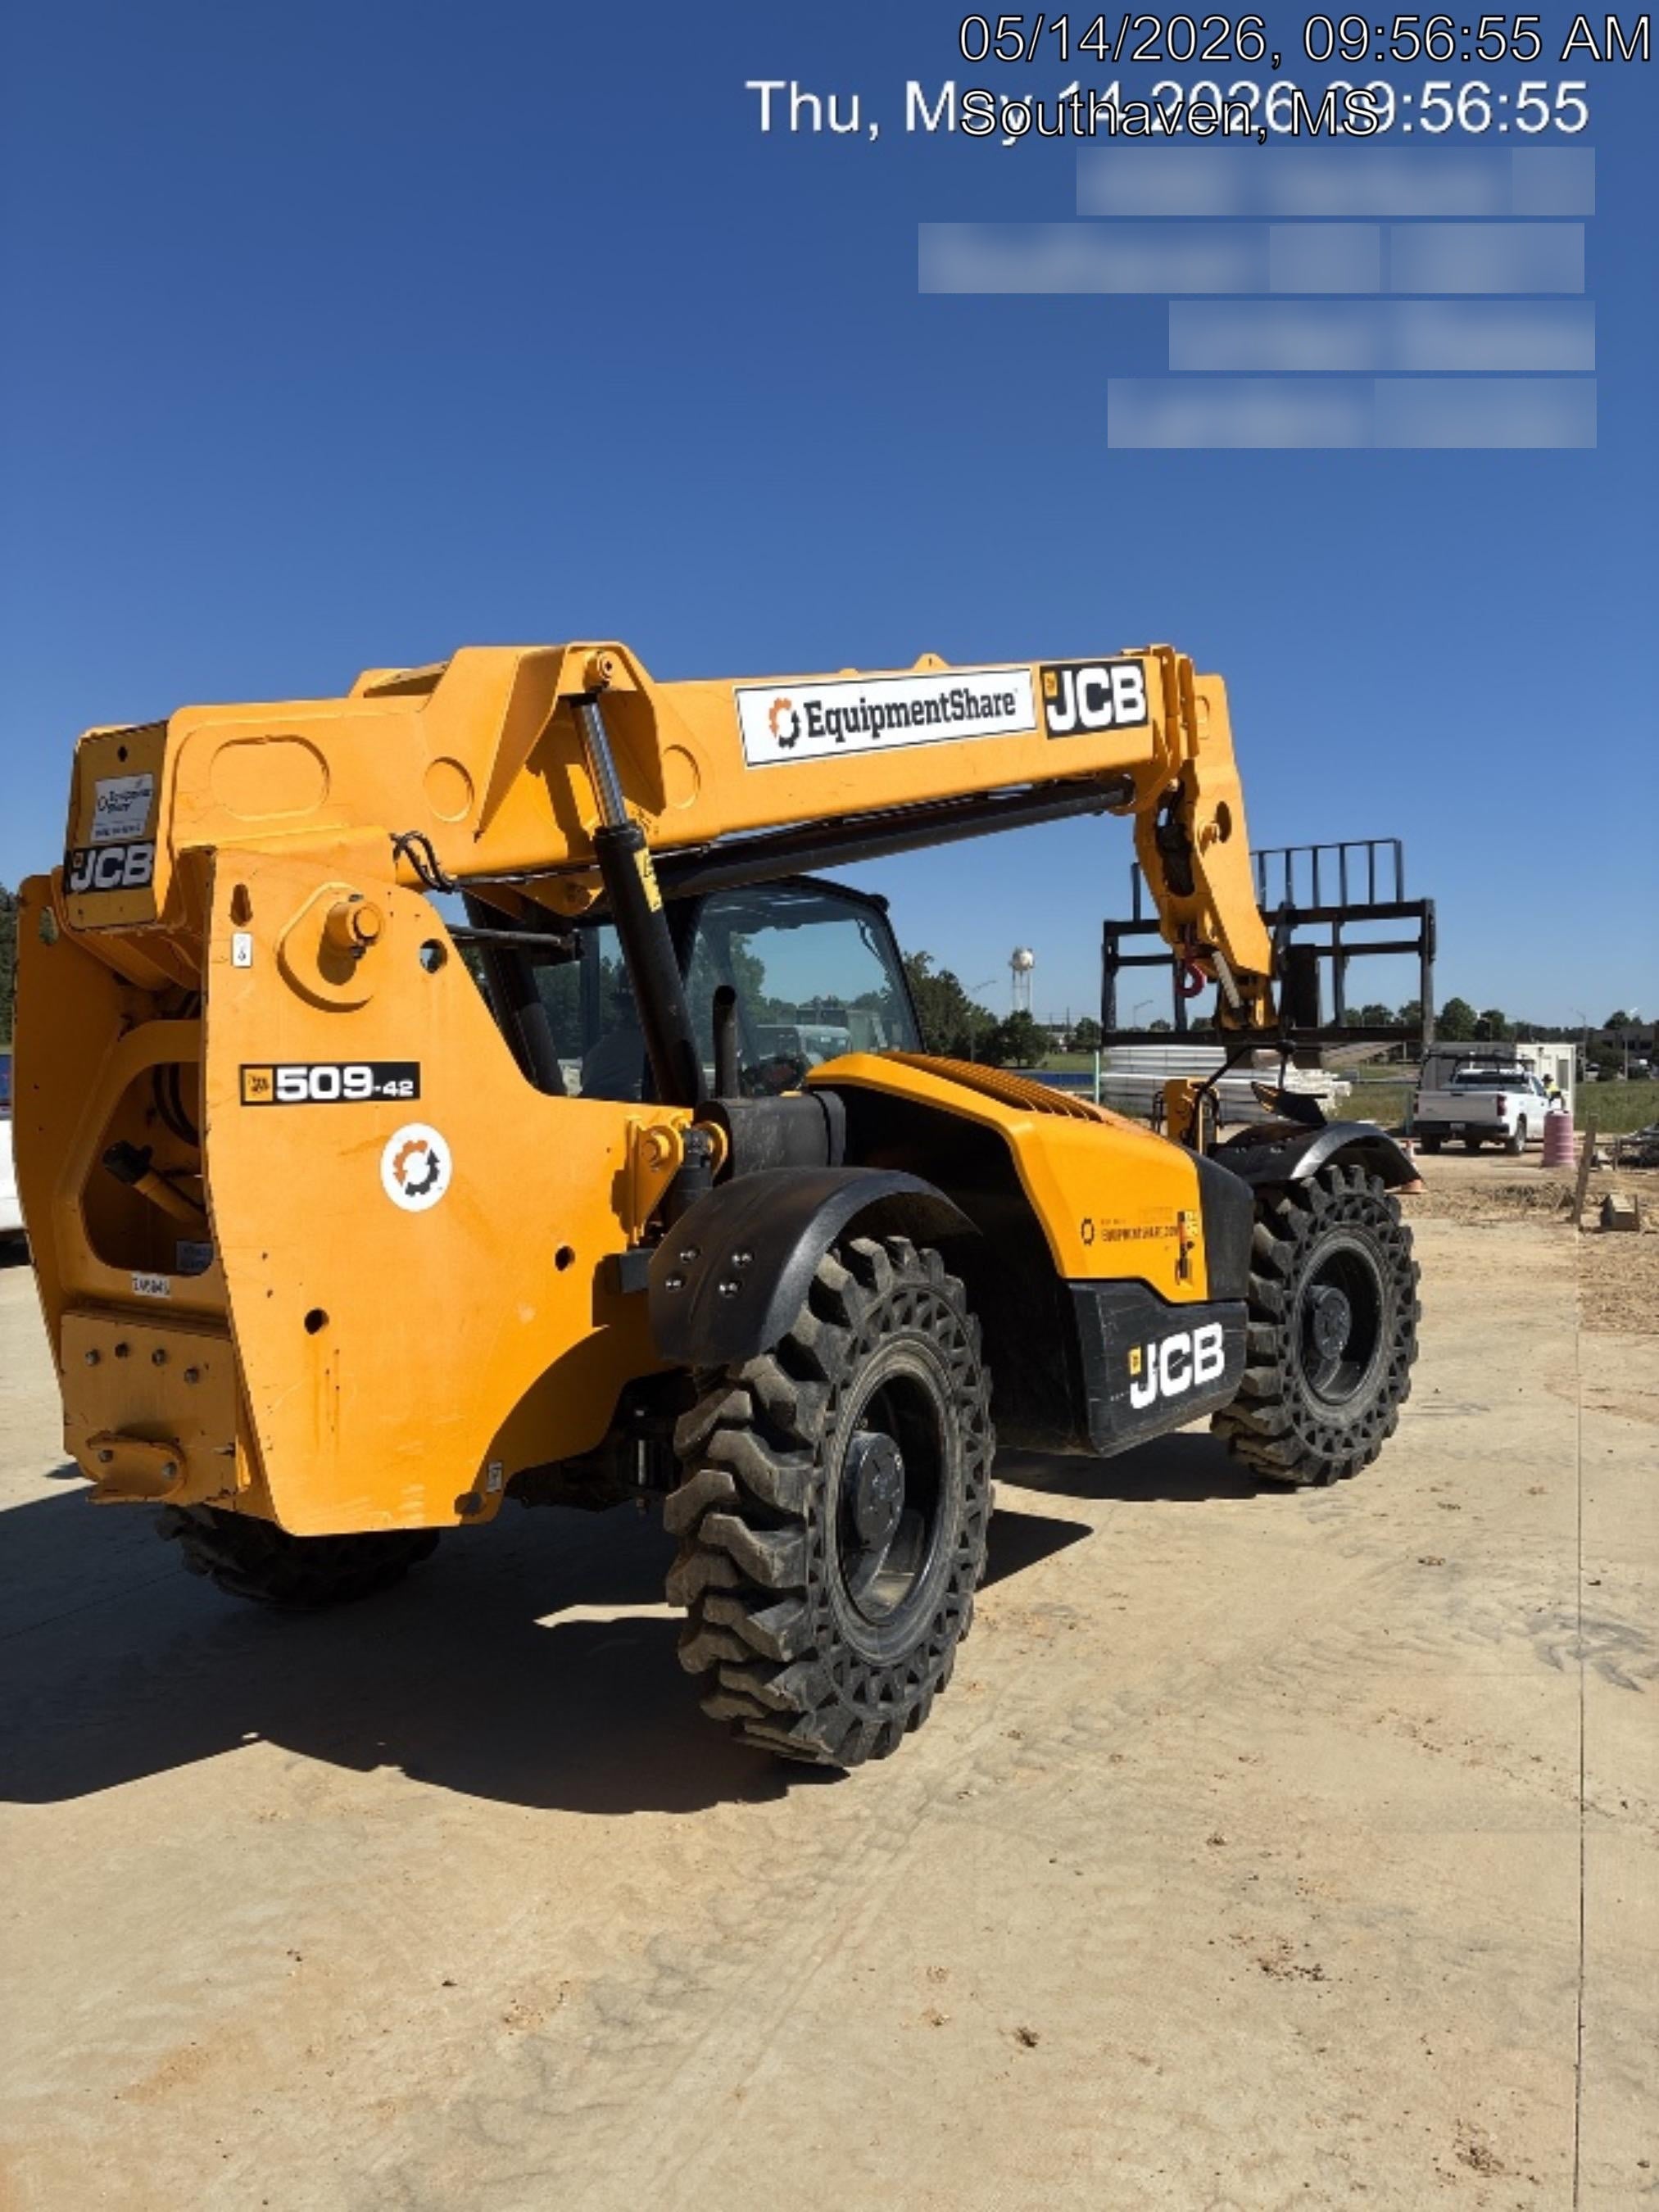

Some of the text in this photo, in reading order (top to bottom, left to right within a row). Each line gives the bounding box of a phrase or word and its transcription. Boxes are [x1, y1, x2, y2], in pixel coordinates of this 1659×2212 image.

[804, 687, 1017, 742] EquipmentShare
[1046, 664, 1146, 732] JCB
[70, 842, 154, 891] JCB
[276, 1065, 414, 1101] 509-42
[1130, 1321, 1225, 1409] JCB
